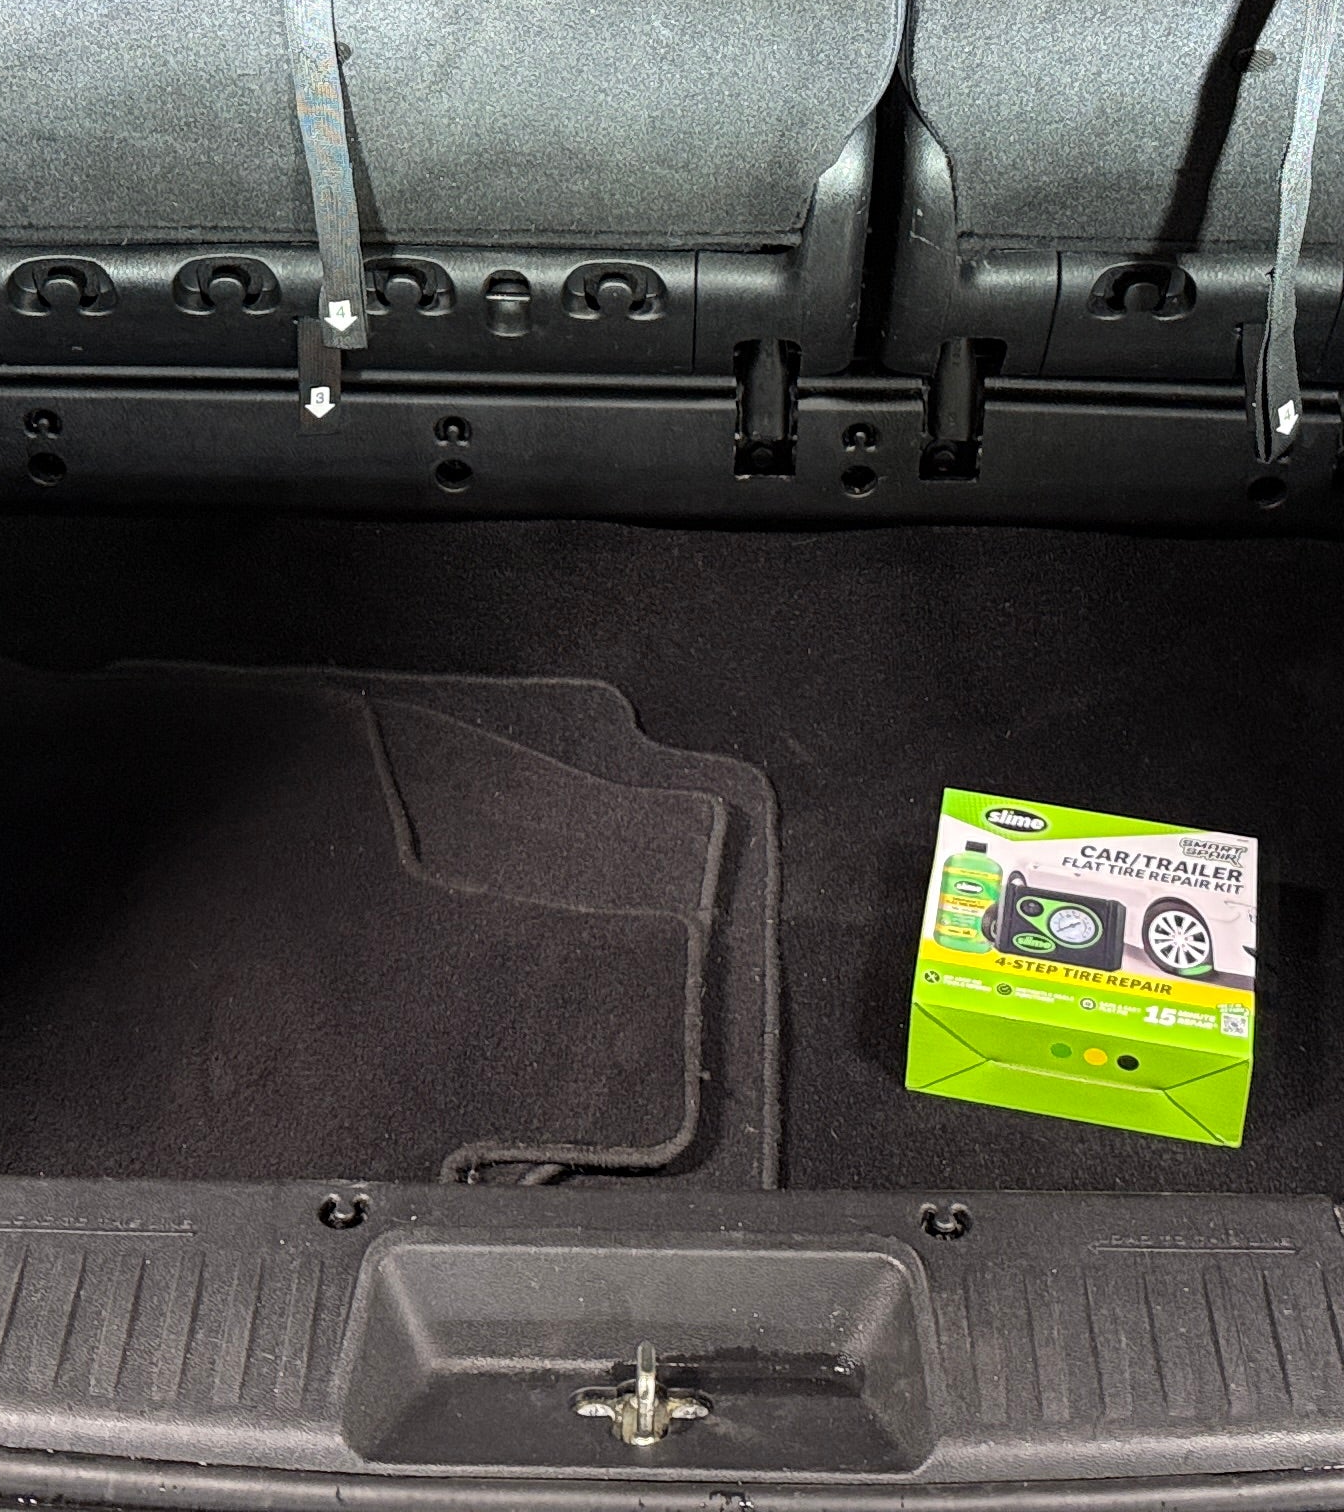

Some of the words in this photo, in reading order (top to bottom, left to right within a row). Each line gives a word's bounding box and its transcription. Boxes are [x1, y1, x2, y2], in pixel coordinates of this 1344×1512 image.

[336, 306, 346, 319] 4
[315, 392, 325, 405] 3
[987, 809, 1046, 831] slime
[1181, 838, 1246, 856] SMART
[1080, 845, 1243, 883] CAR/TRAILER
[1062, 856, 1103, 873] FLAT
[1108, 863, 1145, 879] TIRE
[1150, 869, 1212, 889] REPAIR
[1214, 880, 1244, 895] KIT
[994, 956, 1058, 976] 4-STEP
[1062, 967, 1103, 984] TIRE
[1106, 973, 1173, 996] REPAIR
[1143, 1005, 1177, 1027] 15
